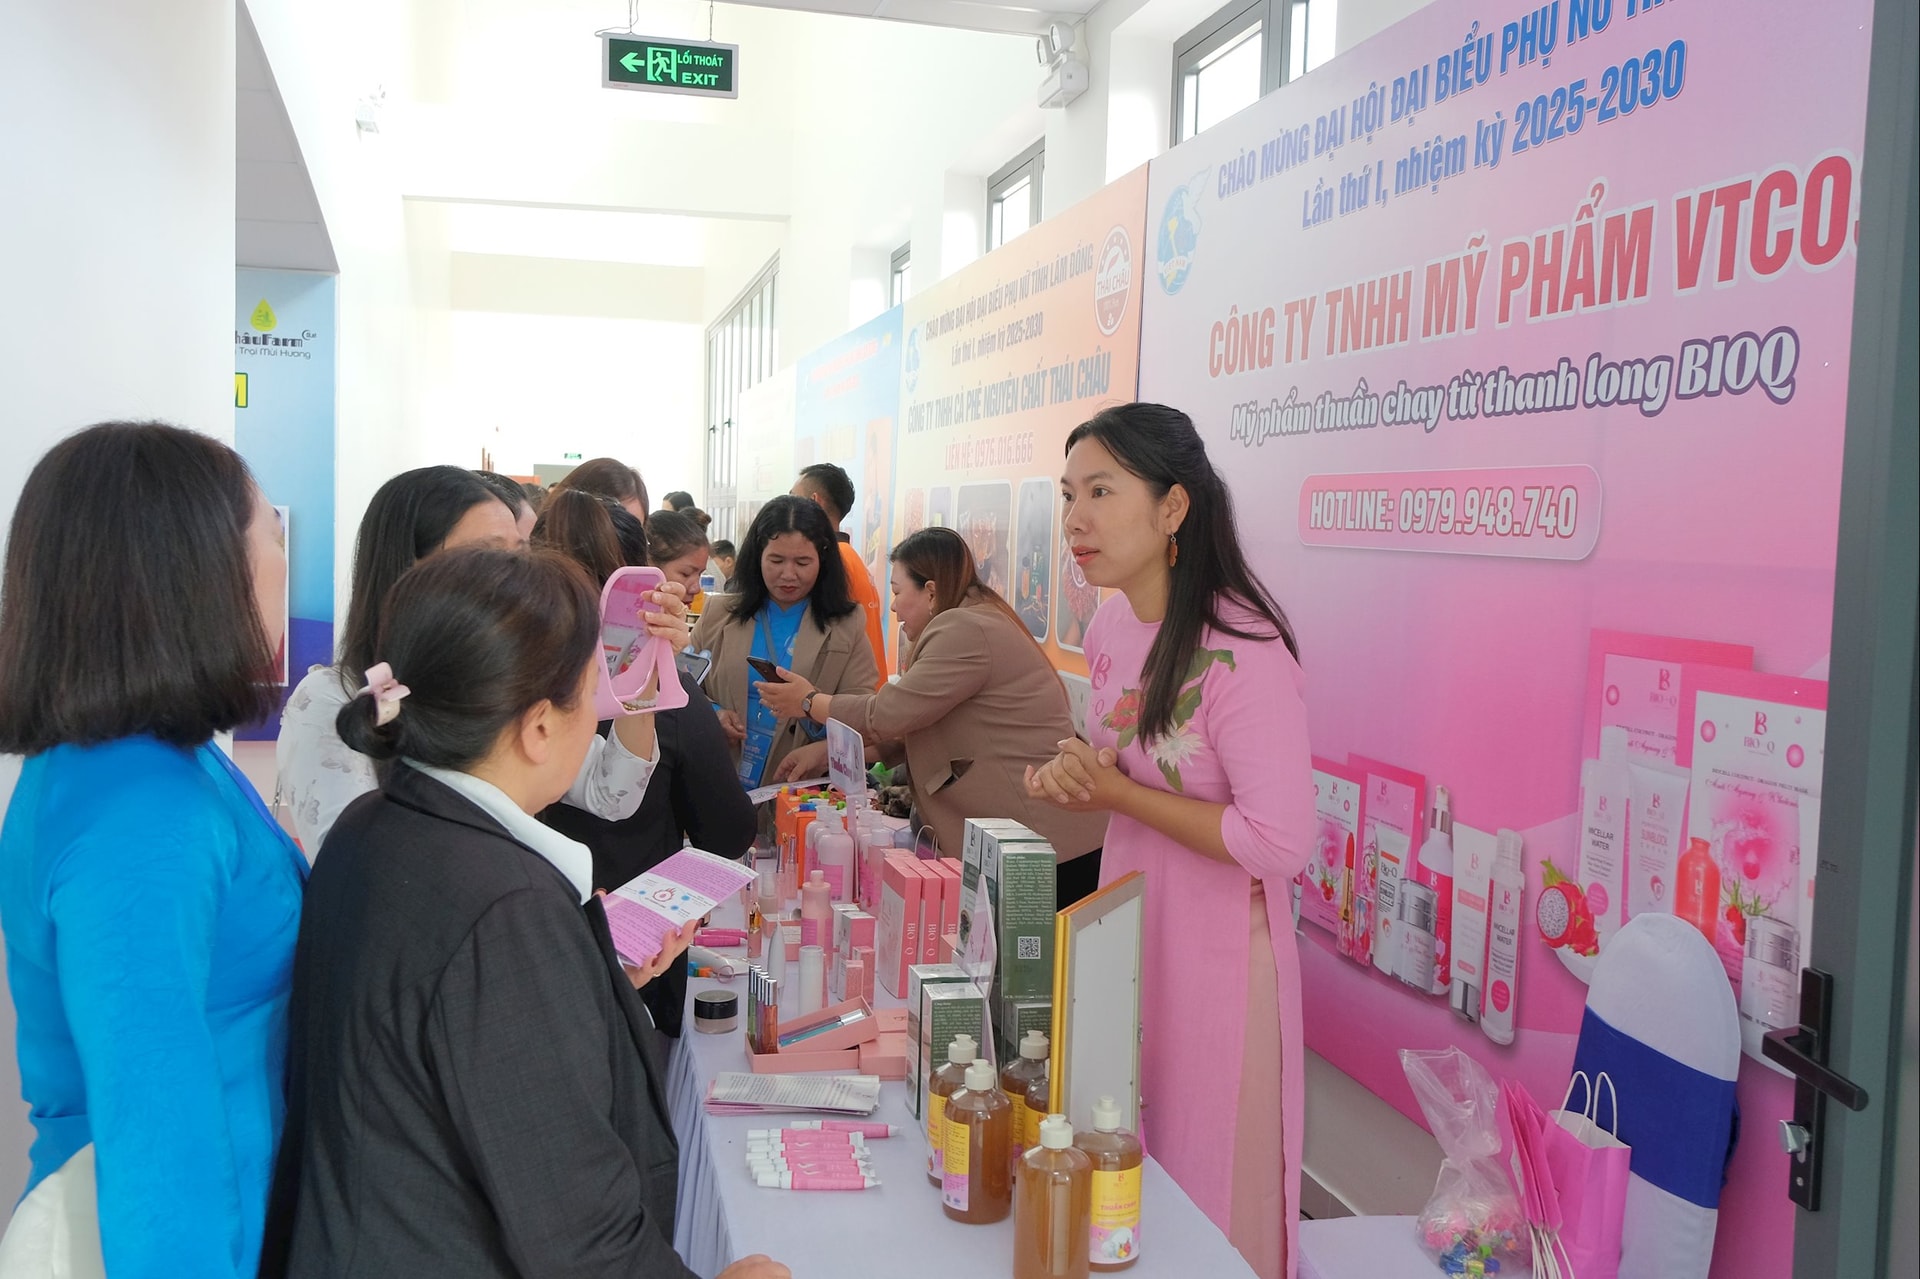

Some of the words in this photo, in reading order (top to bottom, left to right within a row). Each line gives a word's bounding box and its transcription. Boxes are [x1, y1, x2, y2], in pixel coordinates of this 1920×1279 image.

[678, 50, 692, 65] LỐI
[694, 54, 723, 68] THOÁT
[682, 72, 719, 86] EXIT
[1218, 148, 1256, 200] CHÀO
[1260, 123, 1310, 182] MỪNG
[1314, 105, 1347, 161] ĐẠI
[1350, 81, 1386, 144] HỘI
[1390, 64, 1430, 126] ĐẠI
[1435, 20, 1494, 105] BIỂU
[1500, 2, 1559, 68] PHỤ
[1302, 177, 1334, 230] Lần
[1339, 165, 1372, 217] thứ
[1375, 160, 1388, 208] I,
[1394, 135, 1467, 194] nhiệm
[1474, 111, 1507, 169] kỳ
[1512, 39, 1686, 154] 2025-2030
[1004, 284, 1018, 309] PHỤ
[1050, 254, 1067, 287] LÂM
[1209, 304, 1275, 378] CÔNG
[1284, 296, 1317, 364] TY
[1325, 270, 1413, 356] TNHH
[1422, 235, 1488, 338] MỸ
[1498, 182, 1654, 324] PHẨM
[1676, 155, 1860, 290] VTCO
[235, 330, 303, 347] hâuFarm
[1006, 311, 1043, 347] 2025-2030
[908, 400, 924, 434] CÔNG
[926, 398, 934, 430] TY
[935, 394, 952, 428] TNHH
[954, 386, 964, 425] CÀ
[966, 380, 981, 422] PHÊ
[983, 372, 1019, 417] NGUYÊN
[1021, 356, 1048, 411] CHẤT
[1049, 354, 1074, 405] THÁI
[1077, 346, 1111, 399] CHÂU
[1230, 402, 1257, 447] Mỹ
[1258, 386, 1312, 446] phẩm
[1314, 377, 1379, 431] thuần
[1382, 380, 1446, 433] chay
[1448, 369, 1483, 420] từ
[1483, 357, 1581, 416] thanh
[1583, 353, 1674, 417] long
[1676, 326, 1800, 405] BIOQ
[945, 437, 960, 471] LIÊN
[975, 431, 1034, 469] 0976.016.666
[1309, 489, 1394, 532] HOTLINE:
[1399, 485, 1578, 539] 0979.948.740
